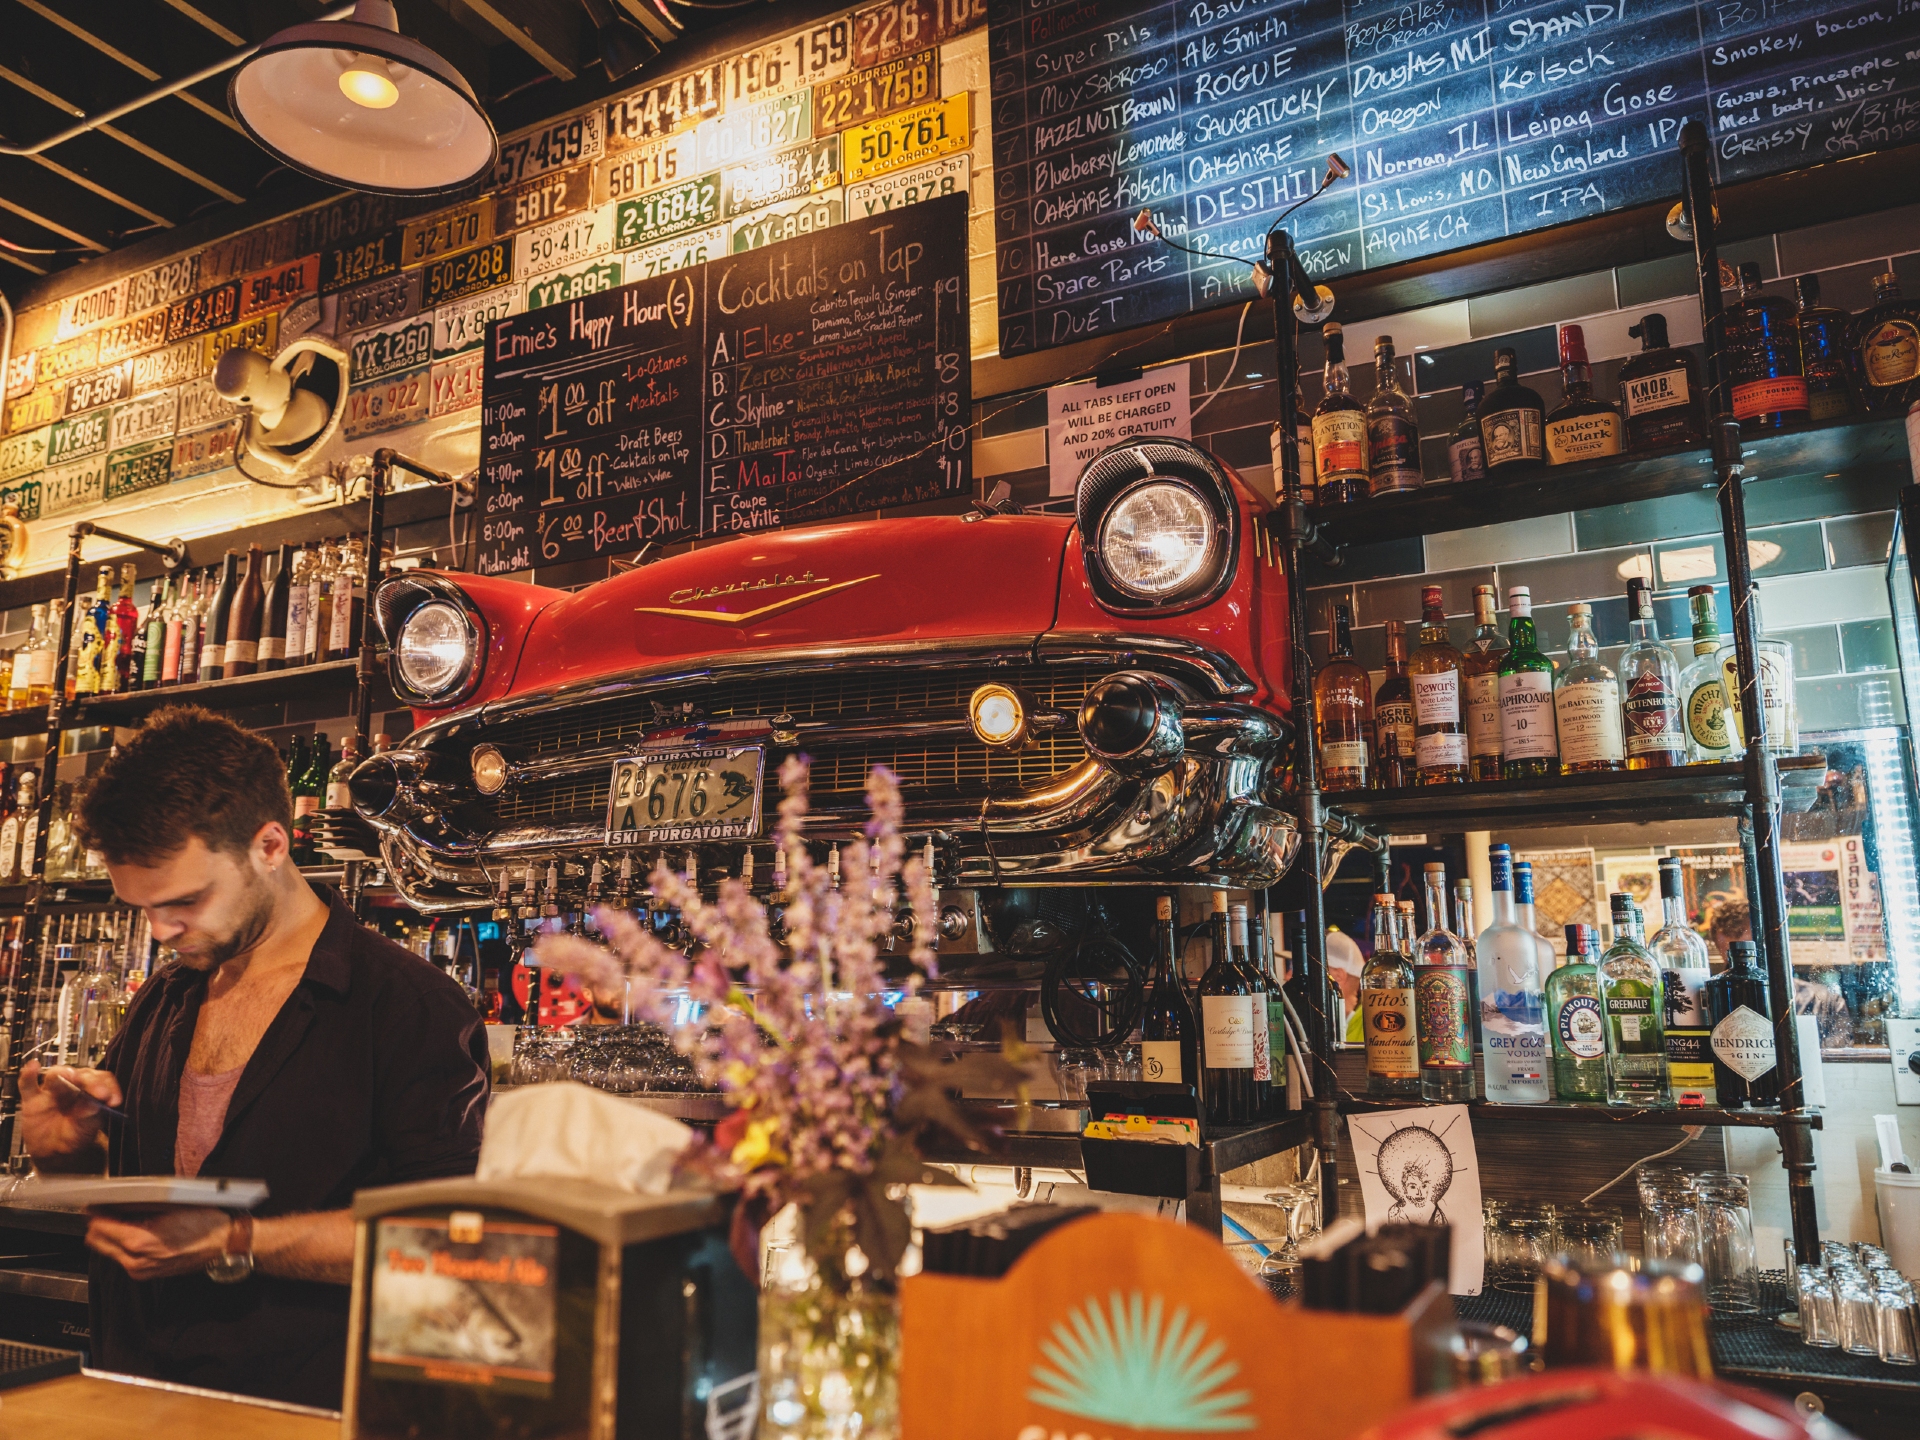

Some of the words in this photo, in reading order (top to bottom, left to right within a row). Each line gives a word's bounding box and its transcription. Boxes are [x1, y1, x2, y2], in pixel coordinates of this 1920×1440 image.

[1223, 17, 1288, 55] Smith
[1450, 26, 1498, 72] MI
[731, 20, 849, 100] 196-159
[1033, 40, 1097, 80] Super
[1103, 24, 1151, 52] Pils
[794, 70, 826, 88] 1924
[844, 59, 905, 88] COLORADO
[1194, 47, 1297, 105] ROGUE
[1790, 57, 1899, 92] Pineapple
[610, 68, 718, 139] 154-411
[1603, 82, 1677, 116] Gose
[874, 106, 940, 132] COLORFUL
[1034, 104, 1121, 155] HAZELNUT
[1719, 109, 1761, 132] Med
[860, 112, 949, 164] 50-761
[1366, 148, 1452, 180] Norman,
[1448, 120, 1488, 157] IL
[873, 144, 938, 172] COLORADO
[1505, 154, 1551, 186] New
[1551, 135, 1629, 173] England
[610, 148, 677, 197] 58T15
[874, 166, 944, 195] COLORADO
[1460, 168, 1492, 197] MO
[642, 183, 698, 205] COLORFUL
[750, 185, 810, 210] COLORADO
[1116, 167, 1177, 209] Kolsch
[1528, 182, 1606, 217] IPA
[515, 182, 567, 226] 58T2
[623, 185, 715, 236] 2-16842
[413, 212, 481, 259] 32-170
[539, 216, 588, 236] COLORFUL
[639, 218, 696, 244] COLORADO
[531, 223, 595, 263] 50-417
[647, 235, 705, 259] COLORADO
[1036, 241, 1080, 270] Here
[1083, 229, 1126, 255] Gose
[537, 248, 588, 272] COLORADO
[717, 243, 829, 316] Cocktails
[839, 259, 867, 284] on
[869, 224, 924, 284] Tap
[1299, 243, 1351, 275] BREW
[441, 279, 490, 300] COLORADO
[885, 281, 923, 302] Ginger
[1037, 274, 1101, 303] Spare
[1101, 255, 1169, 282] Parts
[71, 286, 118, 327] 48006
[453, 294, 503, 316] COLORADO
[854, 309, 876, 323] Rose
[355, 320, 429, 370] YX-1260
[495, 321, 557, 362] Ernie's
[570, 301, 615, 350] Happy
[366, 357, 413, 377] COLORADO
[71, 375, 122, 411] 50-589
[388, 382, 420, 413] 922
[1061, 402, 1081, 414] ALL
[1084, 396, 1113, 409] TABS
[1116, 390, 1142, 404] LEFT
[1144, 382, 1176, 398] OPEN
[1631, 376, 1668, 400] KNOB
[1636, 390, 1675, 404] CREEK
[1766, 386, 1800, 395] BOURBON
[484, 403, 526, 426] 11:00am
[587, 379, 616, 426] off
[1068, 415, 1095, 429] WILL
[1098, 412, 1112, 423] BE
[1115, 401, 1171, 420] CHARGED
[54, 416, 101, 454] YX-985
[654, 427, 683, 446] Beers
[1063, 433, 1088, 446] AND
[1091, 428, 1115, 441] 20%
[1118, 417, 1177, 437] GRATUITY
[1552, 417, 1612, 437] Maker's
[1569, 430, 1612, 444] Mark
[489, 432, 525, 451] 2:00pm
[658, 452, 671, 462] on
[667, 442, 690, 464] Tap
[1564, 442, 1603, 455] WHISKY
[46, 468, 102, 502] YX-1194
[486, 463, 524, 484] 4:00pm
[577, 453, 610, 500] off
[486, 492, 524, 513] 6:00pm
[730, 493, 767, 510] Coupe
[484, 520, 524, 541] 8:00pm
[478, 546, 530, 574] Midnight
[669, 570, 830, 604] Chevrolet
[1416, 681, 1456, 694] Dewar's
[1567, 698, 1605, 707] BALVENIE
[1626, 697, 1678, 711] RITTENHOUSE
[1482, 713, 1494, 723] 12
[1517, 719, 1528, 730] 10
[1576, 724, 1585, 732] 12
[1642, 718, 1664, 727] RYE
[646, 748, 726, 764] DURANGO
[618, 768, 646, 799] 28
[648, 772, 708, 820] 676
[621, 806, 637, 830] A
[612, 831, 638, 844] SKI
[650, 824, 744, 842] PURGATORY
[1560, 998, 1601, 1029] PLYMOUTH
[1369, 1036, 1415, 1048] Handmade
[1490, 1037, 1515, 1048] GREY
[1507, 1050, 1541, 1058] VODKA
